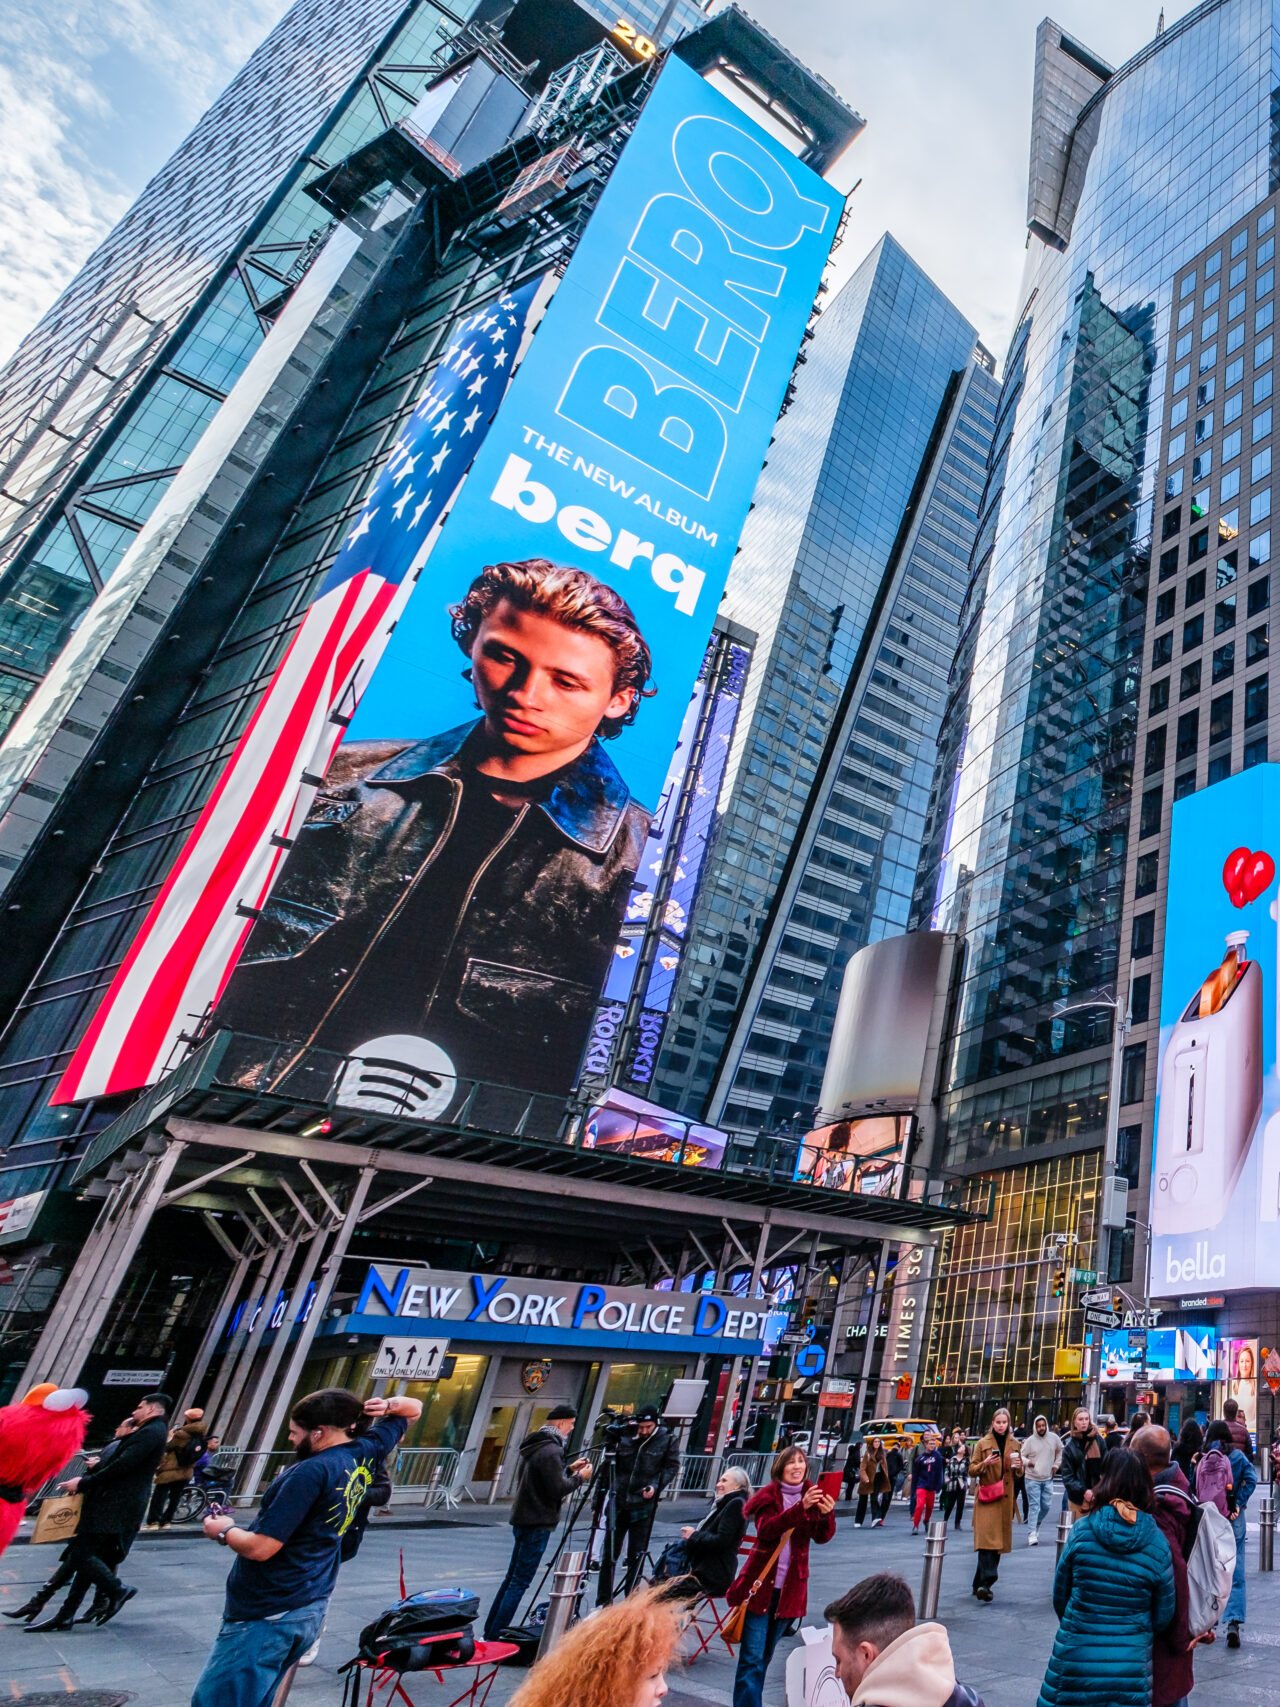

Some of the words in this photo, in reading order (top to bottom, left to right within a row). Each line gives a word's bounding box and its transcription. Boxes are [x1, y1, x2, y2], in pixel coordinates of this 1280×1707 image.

[555, 115, 829, 501] BERQ
[522, 425, 573, 466] THE
[572, 456, 635, 499] NEW
[634, 494, 718, 547] ALBUM
[490, 453, 706, 616] berq
[1166, 1241, 1226, 1284] bella
[355, 1265, 462, 1318] NEW
[466, 1275, 567, 1327] YORK
[572, 1285, 686, 1335] POLICE
[694, 1295, 772, 1340] DEPT
[1083, 1296, 1094, 1304] ONE
[1097, 1293, 1108, 1301] WAY
[1090, 1312, 1101, 1322] ONE
[1105, 1314, 1118, 1325] WAY
[846, 1325, 889, 1338] CHASE
[893, 1297, 916, 1362] TIMES
[374, 1367, 394, 1376] ONLY
[396, 1368, 415, 1376] ONLY
[417, 1369, 437, 1377] ONLY
